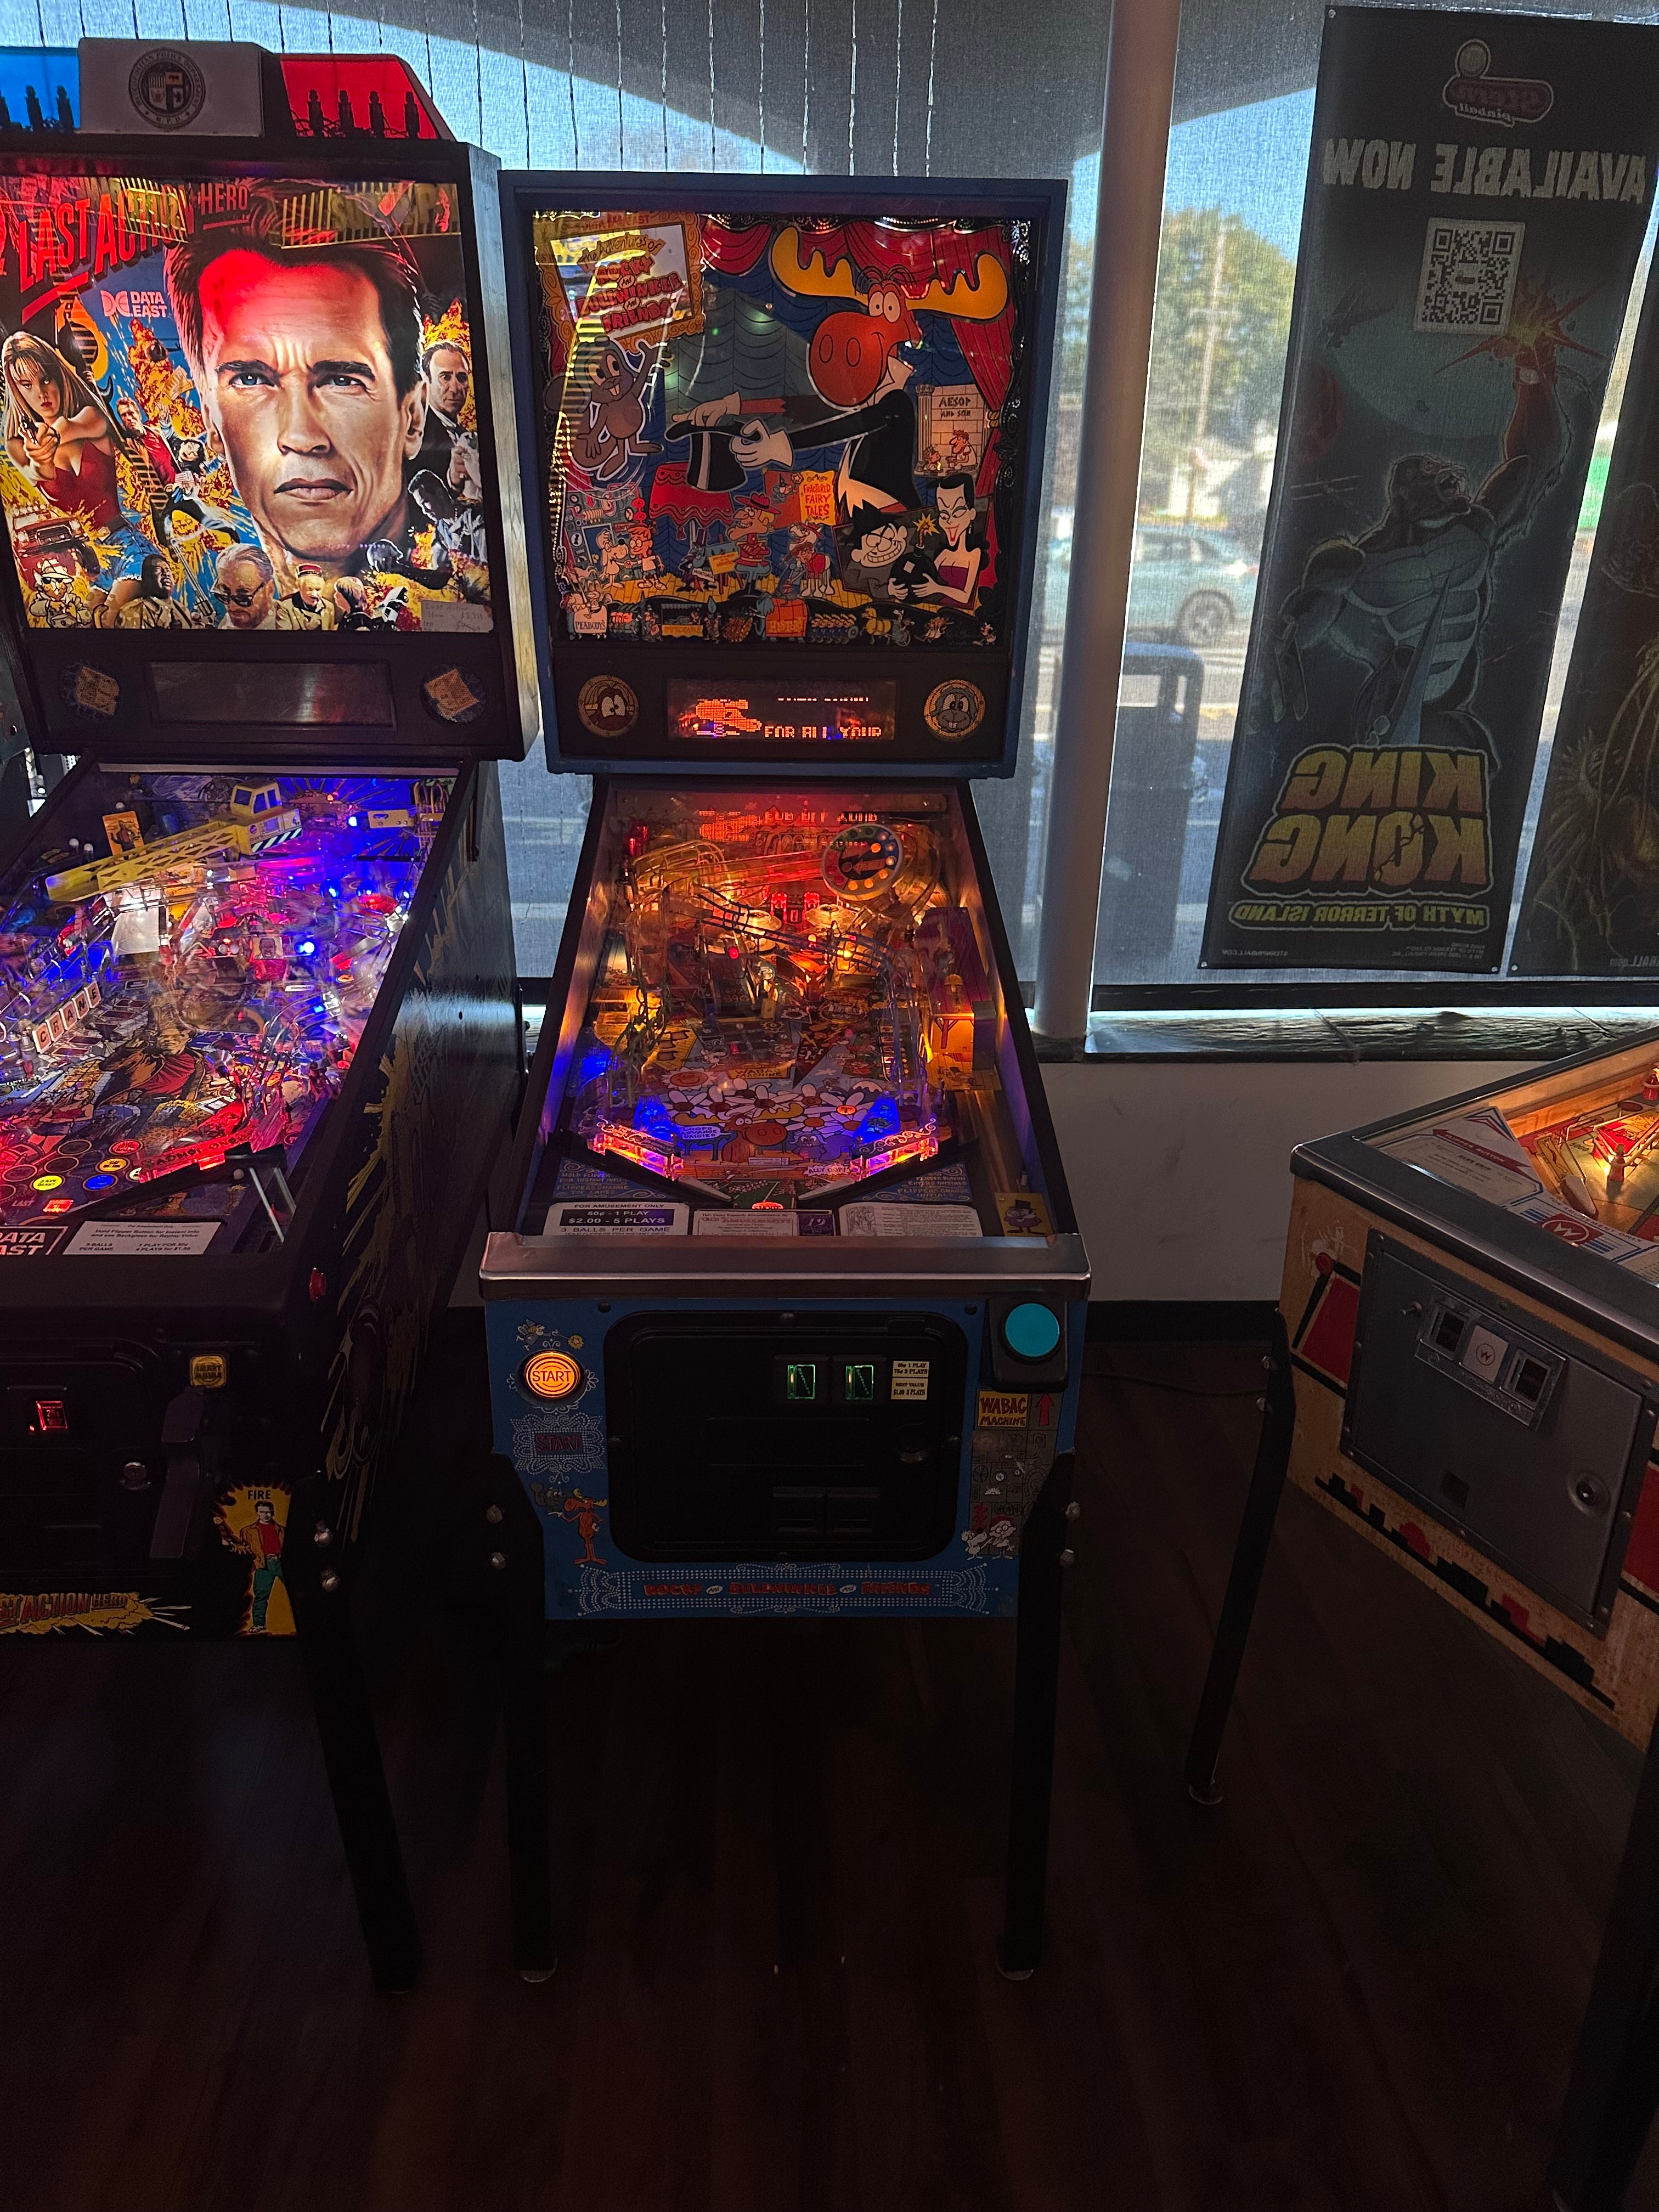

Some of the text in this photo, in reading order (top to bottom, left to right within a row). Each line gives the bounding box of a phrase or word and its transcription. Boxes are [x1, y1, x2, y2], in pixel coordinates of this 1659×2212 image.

[19, 198, 91, 293] LAST
[200, 183, 249, 216] HERO
[597, 256, 653, 284] ROCKY
[621, 277, 633, 287] And
[131, 291, 165, 304] DATA
[576, 273, 681, 315] BULLWINKLE
[627, 298, 638, 308] And
[133, 304, 167, 318] EAST
[939, 396, 971, 408] AESOP
[803, 483, 831, 494] FRACTURED
[805, 494, 832, 504] FAIRY
[804, 504, 830, 517] TALES
[575, 619, 606, 630] PEABODY'S
[770, 617, 804, 630] HISTORY
[1444, 1133, 1505, 1163] FLIPPER BUTTON
[1569, 1142, 1589, 1152] 5000
[0, 1232, 46, 1243] ATA
[1618, 1233, 1642, 1242] ONLY
[0, 1244, 44, 1255] AST
[531, 1370, 572, 1383] START
[980, 1397, 1028, 1415] WABAC
[980, 1415, 1027, 1426] MACHINE
[535, 1434, 583, 1452] START
[247, 1489, 271, 1500] FIRE
[644, 1584, 703, 1596] ROCKY
[729, 1582, 837, 1596] BULLWINKLE
[860, 1582, 932, 1596] FRIENDS
[0, 1593, 128, 1624] ST ACTION HERO
